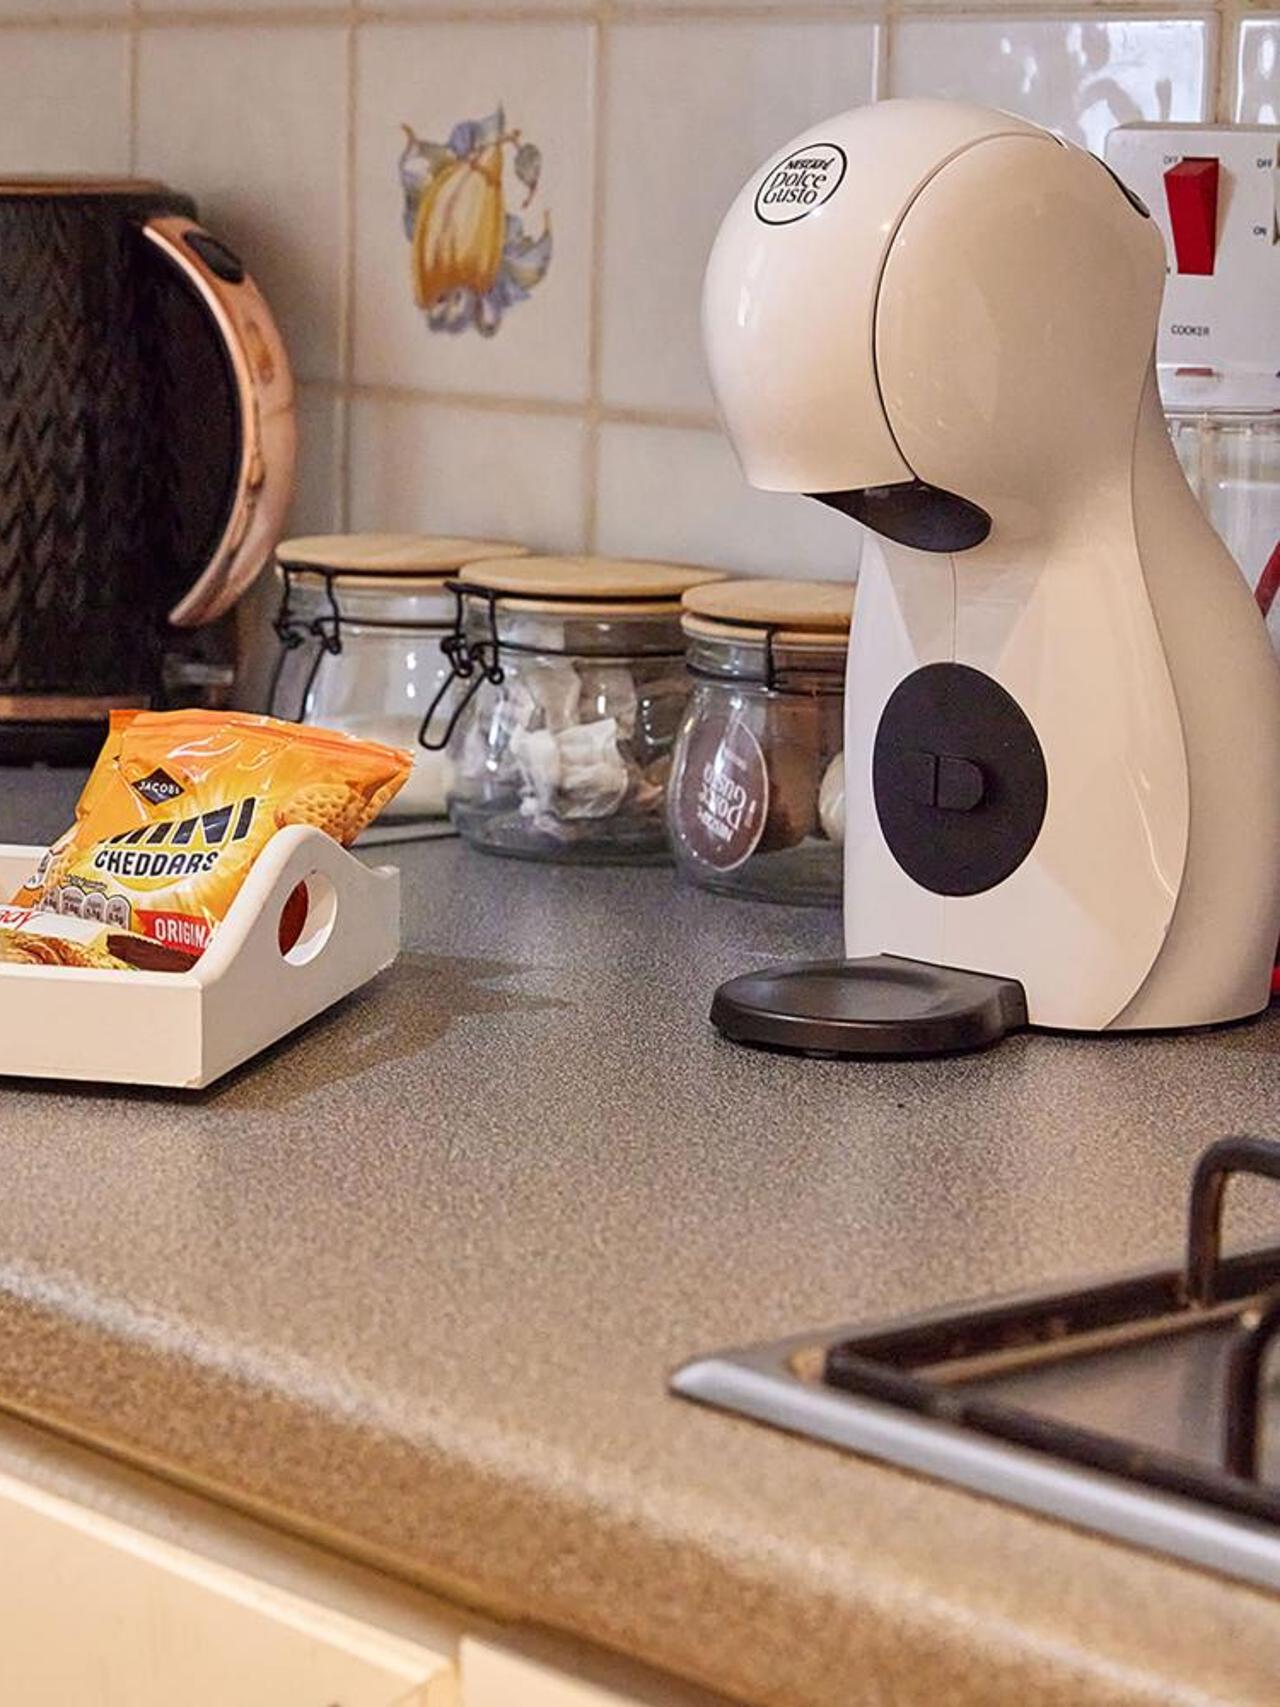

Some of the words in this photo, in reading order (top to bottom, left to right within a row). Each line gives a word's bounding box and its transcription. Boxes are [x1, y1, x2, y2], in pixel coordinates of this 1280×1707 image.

[1256, 158, 1272, 169] OFF
[770, 170, 827, 190] Dolce
[763, 187, 818, 205] Gusto
[1252, 225, 1267, 236] ON
[1170, 324, 1210, 336] COOKER
[98, 796, 257, 845] MINI
[94, 850, 219, 876] CHEDDARS
[154, 917, 207, 948] ORIGIN
